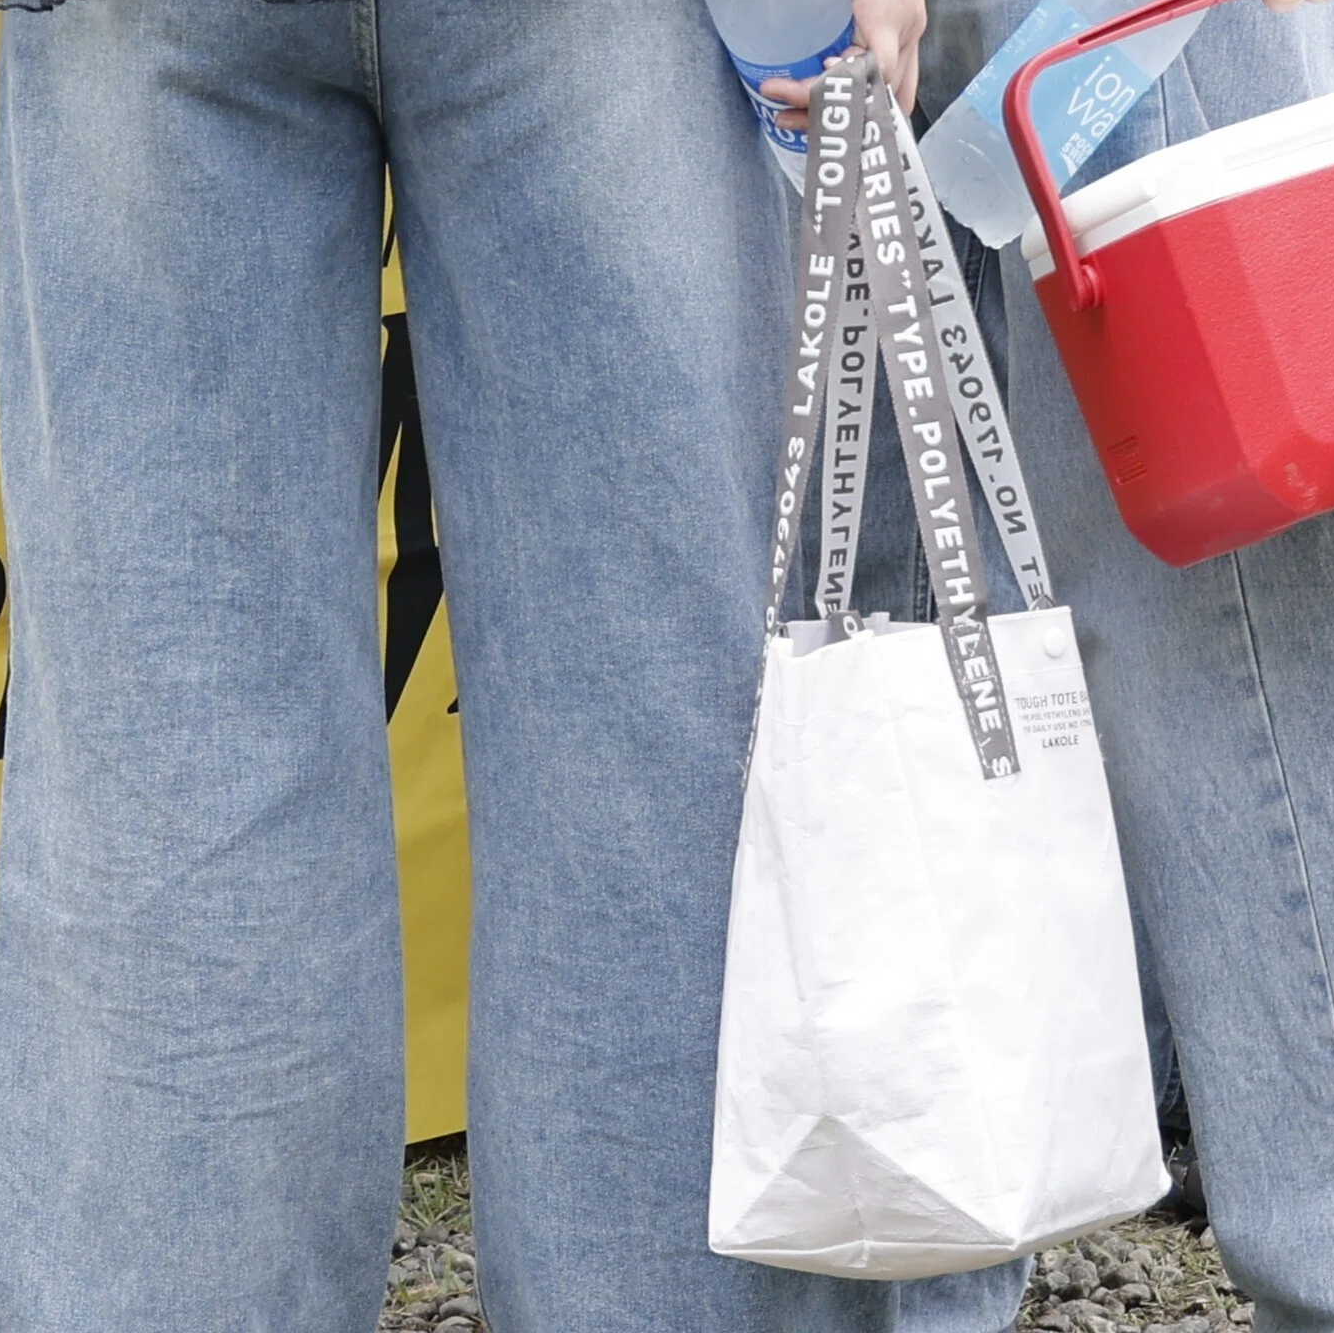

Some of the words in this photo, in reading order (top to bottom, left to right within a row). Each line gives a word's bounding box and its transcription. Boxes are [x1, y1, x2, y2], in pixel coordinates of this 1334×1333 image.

[1083, 54, 1136, 114] ion
[792, 253, 836, 417] LAKOLE
[1042, 734, 1079, 749] LAKOLE
